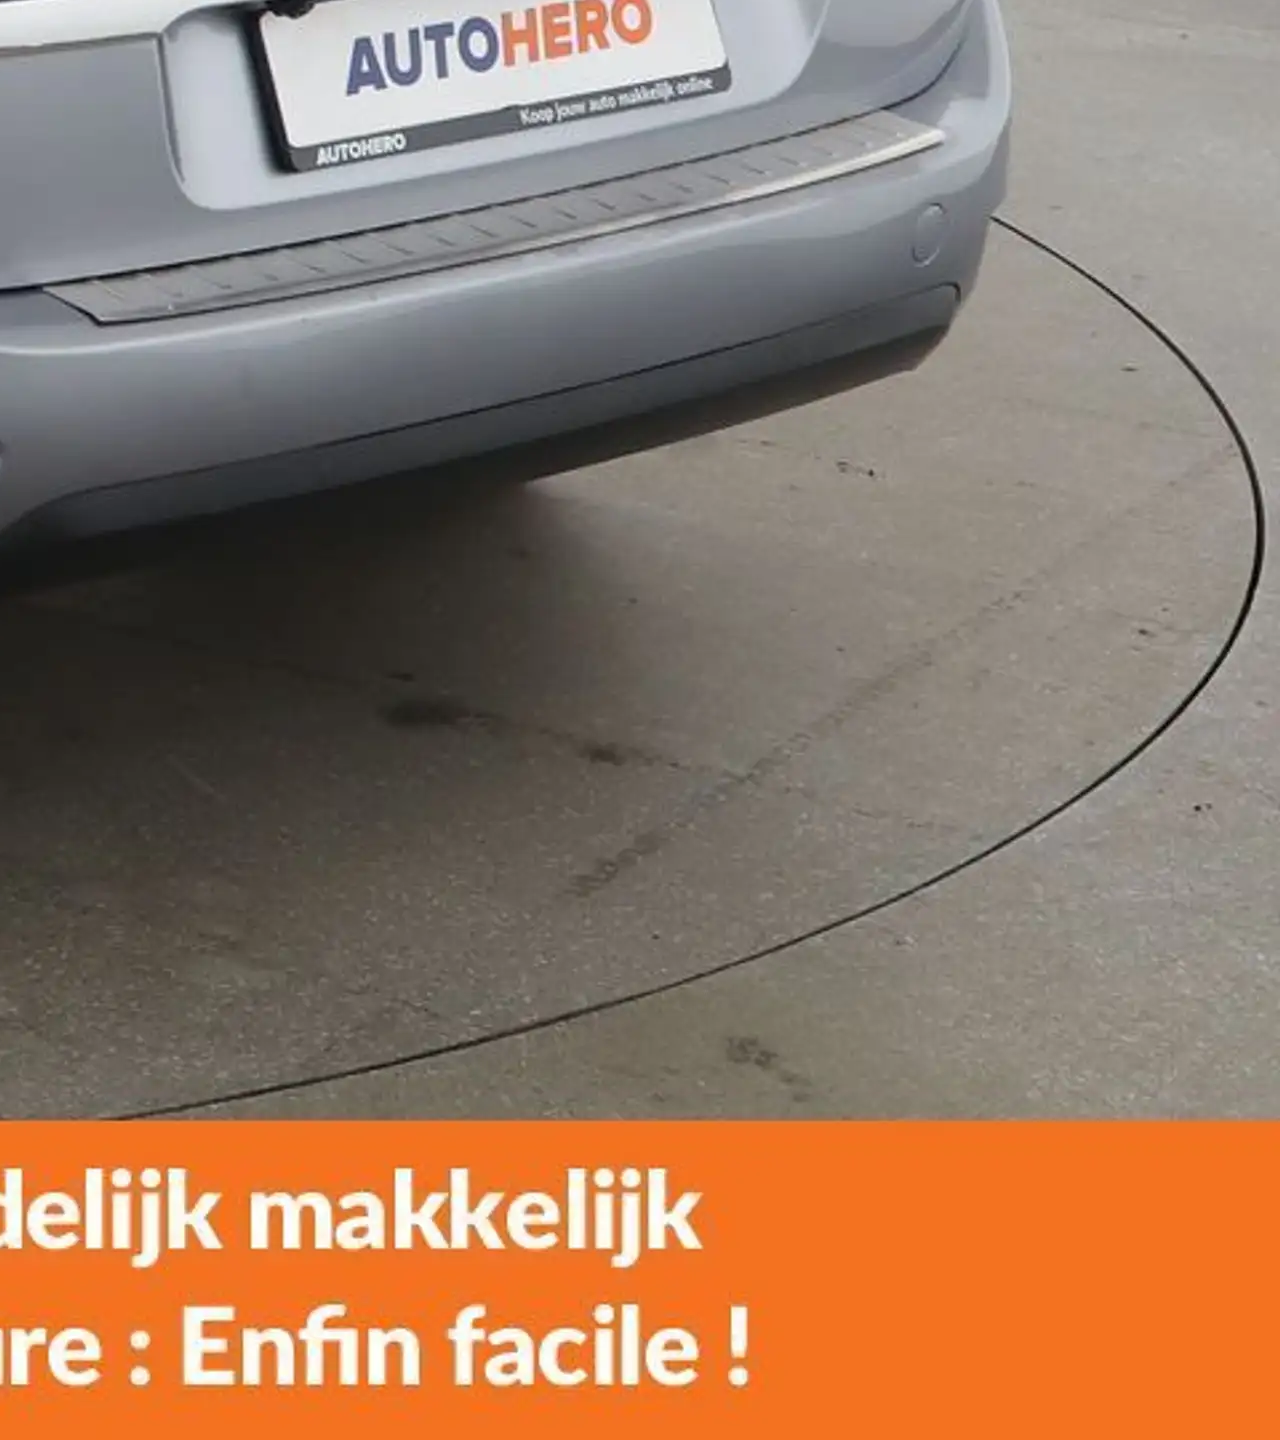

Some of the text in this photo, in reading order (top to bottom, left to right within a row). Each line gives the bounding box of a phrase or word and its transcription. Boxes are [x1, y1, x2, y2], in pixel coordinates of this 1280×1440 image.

[519, 75, 714, 126] Koop jouw auto makkelijk online
[315, 132, 407, 166] AUTOHERO
